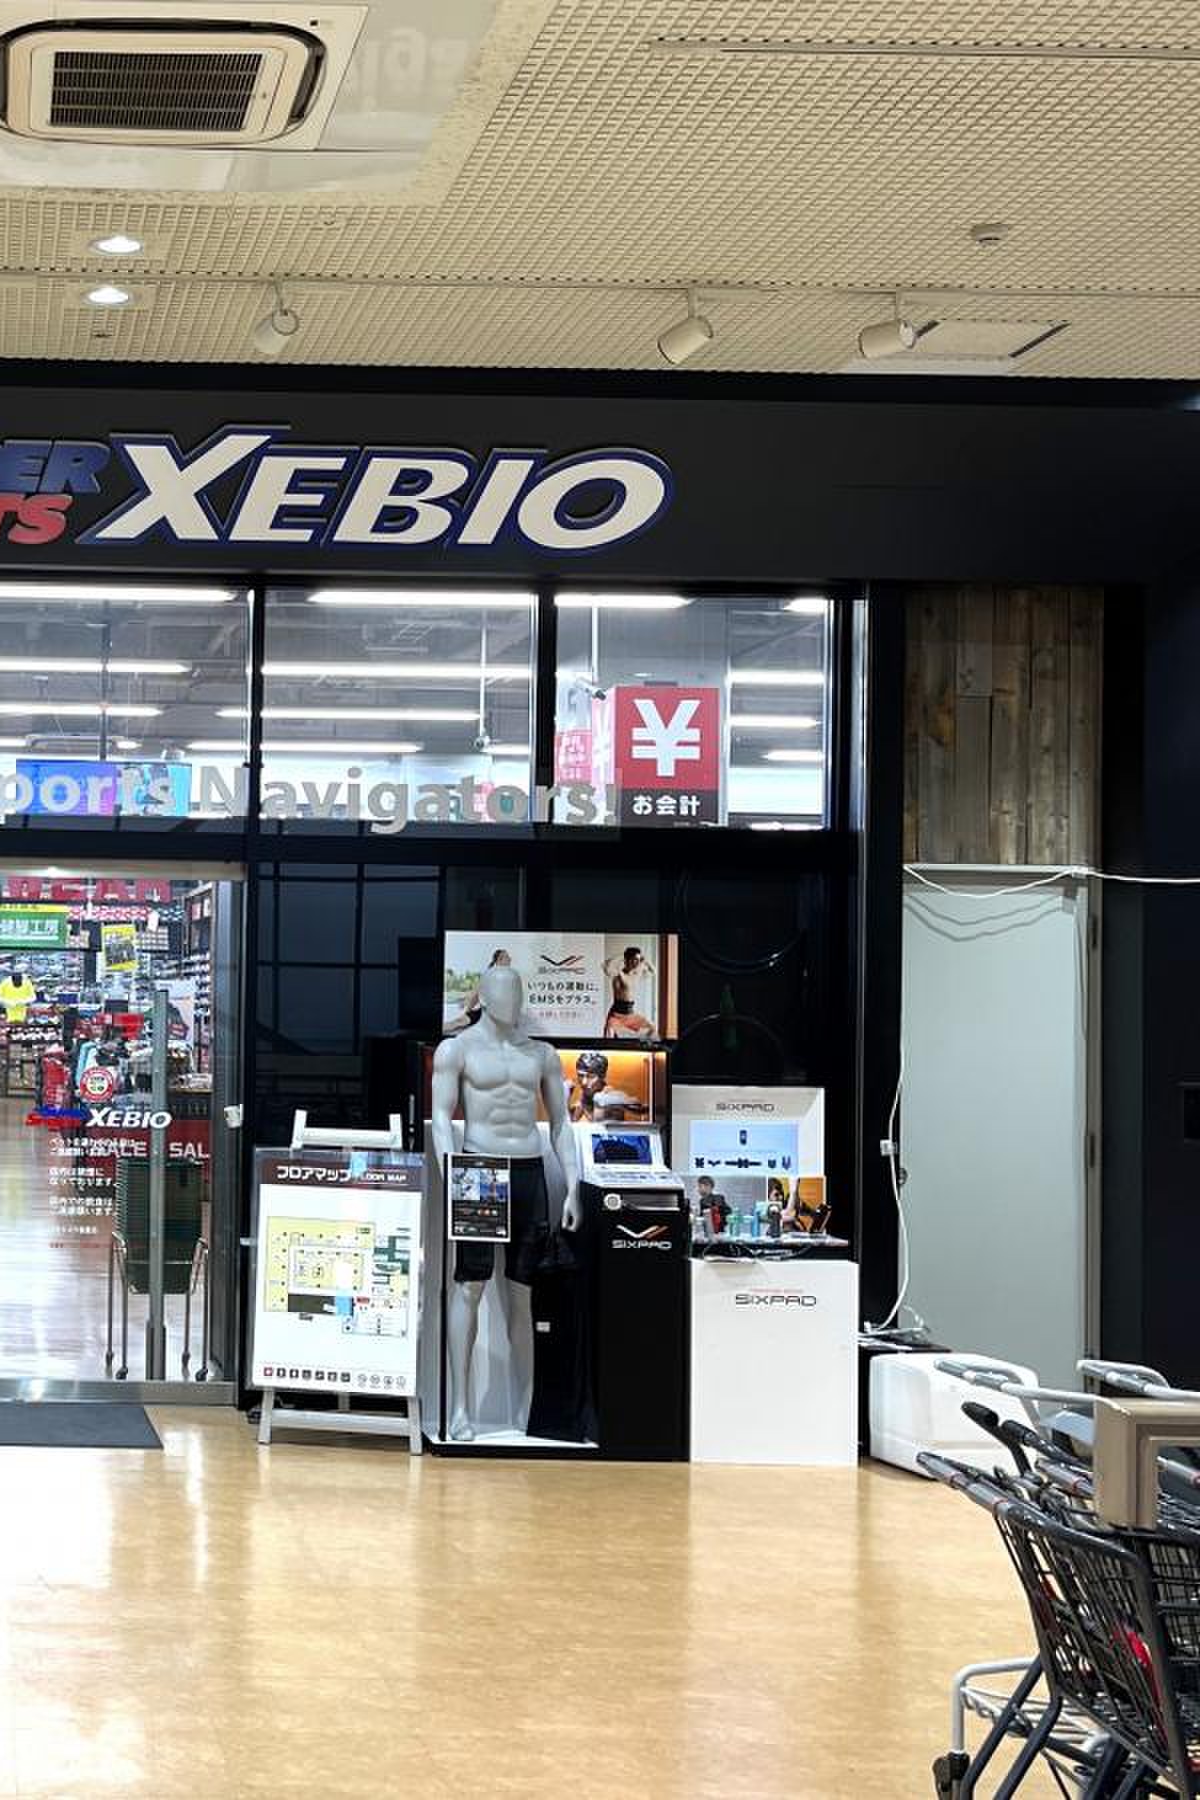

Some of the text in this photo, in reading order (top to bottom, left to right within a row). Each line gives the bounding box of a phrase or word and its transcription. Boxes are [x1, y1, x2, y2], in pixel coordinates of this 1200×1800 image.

[80, 424, 672, 551] XEBIO
[200, 764, 618, 833] Navigators!
[632, 795, 701, 816] お会計
[86, 1107, 173, 1129] XEBIO
[611, 1239, 672, 1250] SIXPAD
[734, 1293, 817, 1307] SIXPAD
